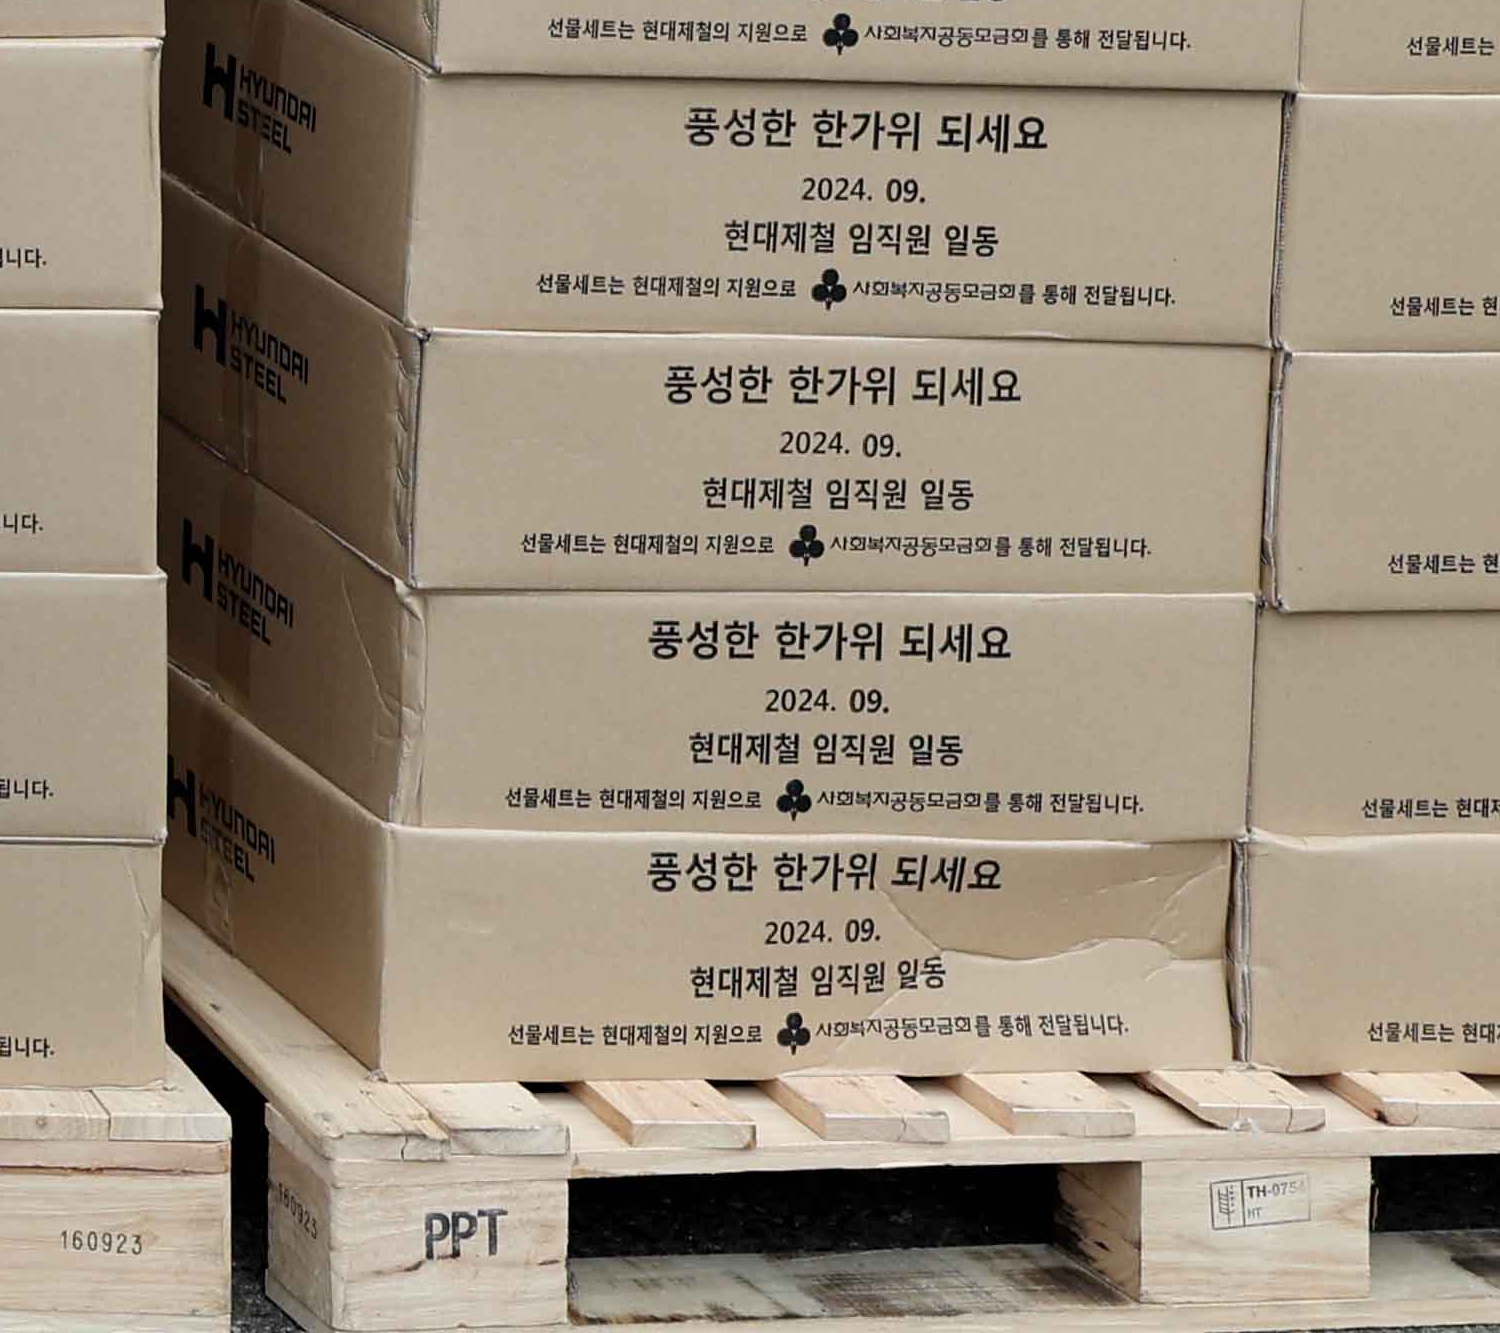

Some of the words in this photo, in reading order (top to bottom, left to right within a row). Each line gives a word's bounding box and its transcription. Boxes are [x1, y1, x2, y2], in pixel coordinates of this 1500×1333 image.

[646, 851, 759, 893] 풍성한
[773, 851, 878, 893] 한가위
[890, 853, 1003, 894] 되세요
[764, 919, 833, 946] 2024.
[844, 917, 881, 944] 09.
[689, 964, 798, 1000] 현대제철
[810, 960, 886, 998] 임직원
[897, 954, 947, 990] 일동
[507, 1023, 596, 1046] 선물세트는
[601, 1024, 688, 1047] 현대제철의
[693, 1023, 763, 1046] 지원으로
[997, 1014, 1033, 1038] 통해
[1037, 1013, 1129, 1037] 전달됩니다.
[60, 1229, 143, 1255] 160923
[424, 1207, 509, 1261] PPT
